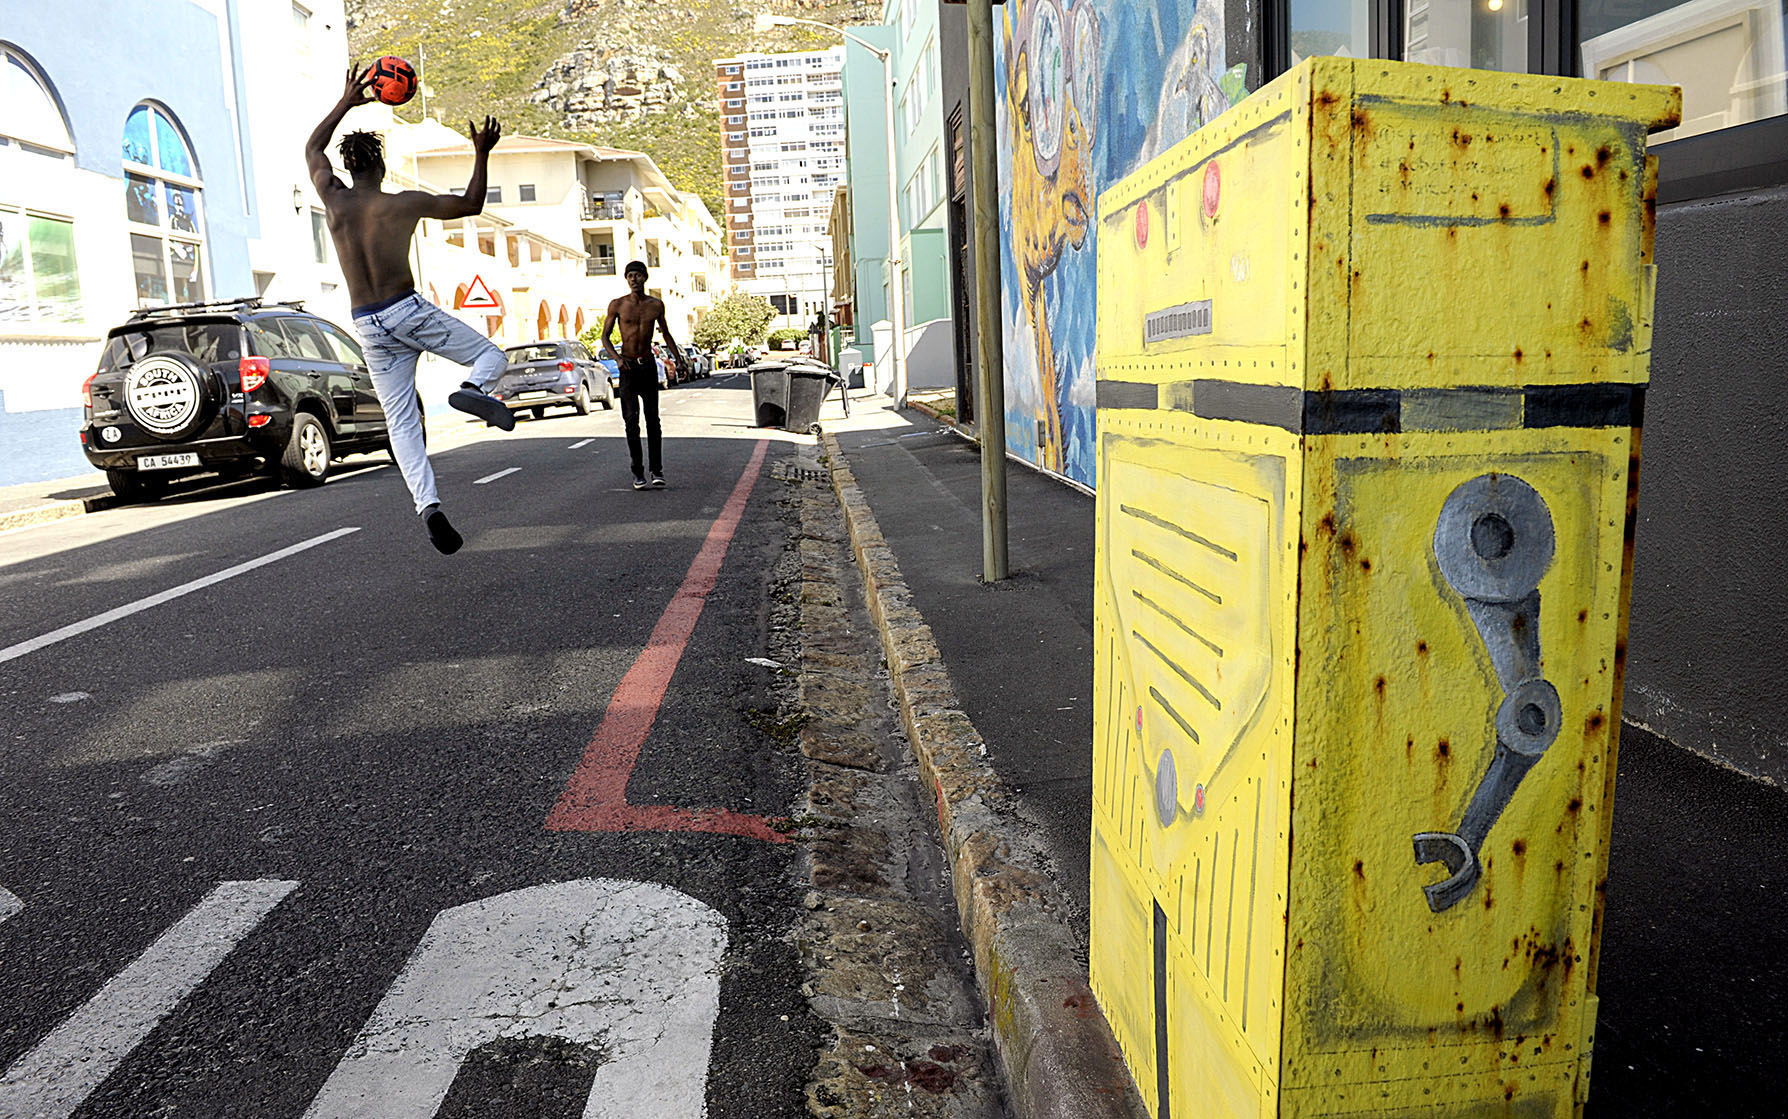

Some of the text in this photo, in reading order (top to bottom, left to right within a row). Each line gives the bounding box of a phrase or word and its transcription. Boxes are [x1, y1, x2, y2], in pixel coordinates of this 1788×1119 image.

[139, 367, 178, 387] SOUTH
[145, 403, 184, 420] AFRICA
[143, 454, 192, 468] CA 54439
